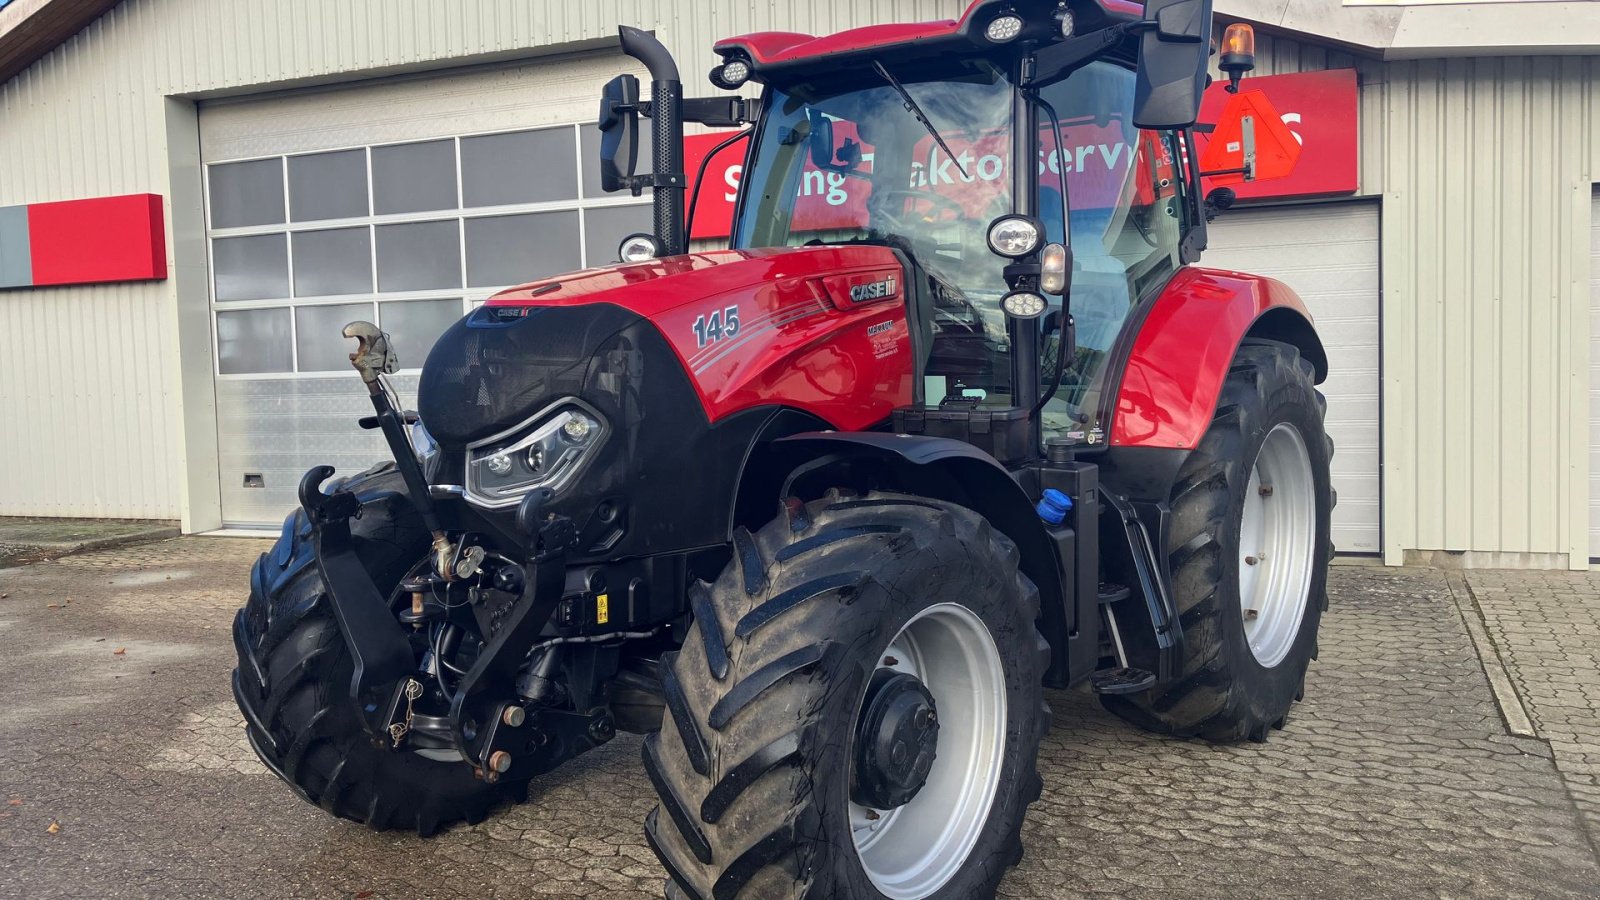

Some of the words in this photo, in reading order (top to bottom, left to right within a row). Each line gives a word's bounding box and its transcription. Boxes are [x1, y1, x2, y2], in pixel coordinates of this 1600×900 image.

[850, 282, 885, 302] CASE
[497, 309, 519, 317] CASE
[692, 304, 740, 349] 145
